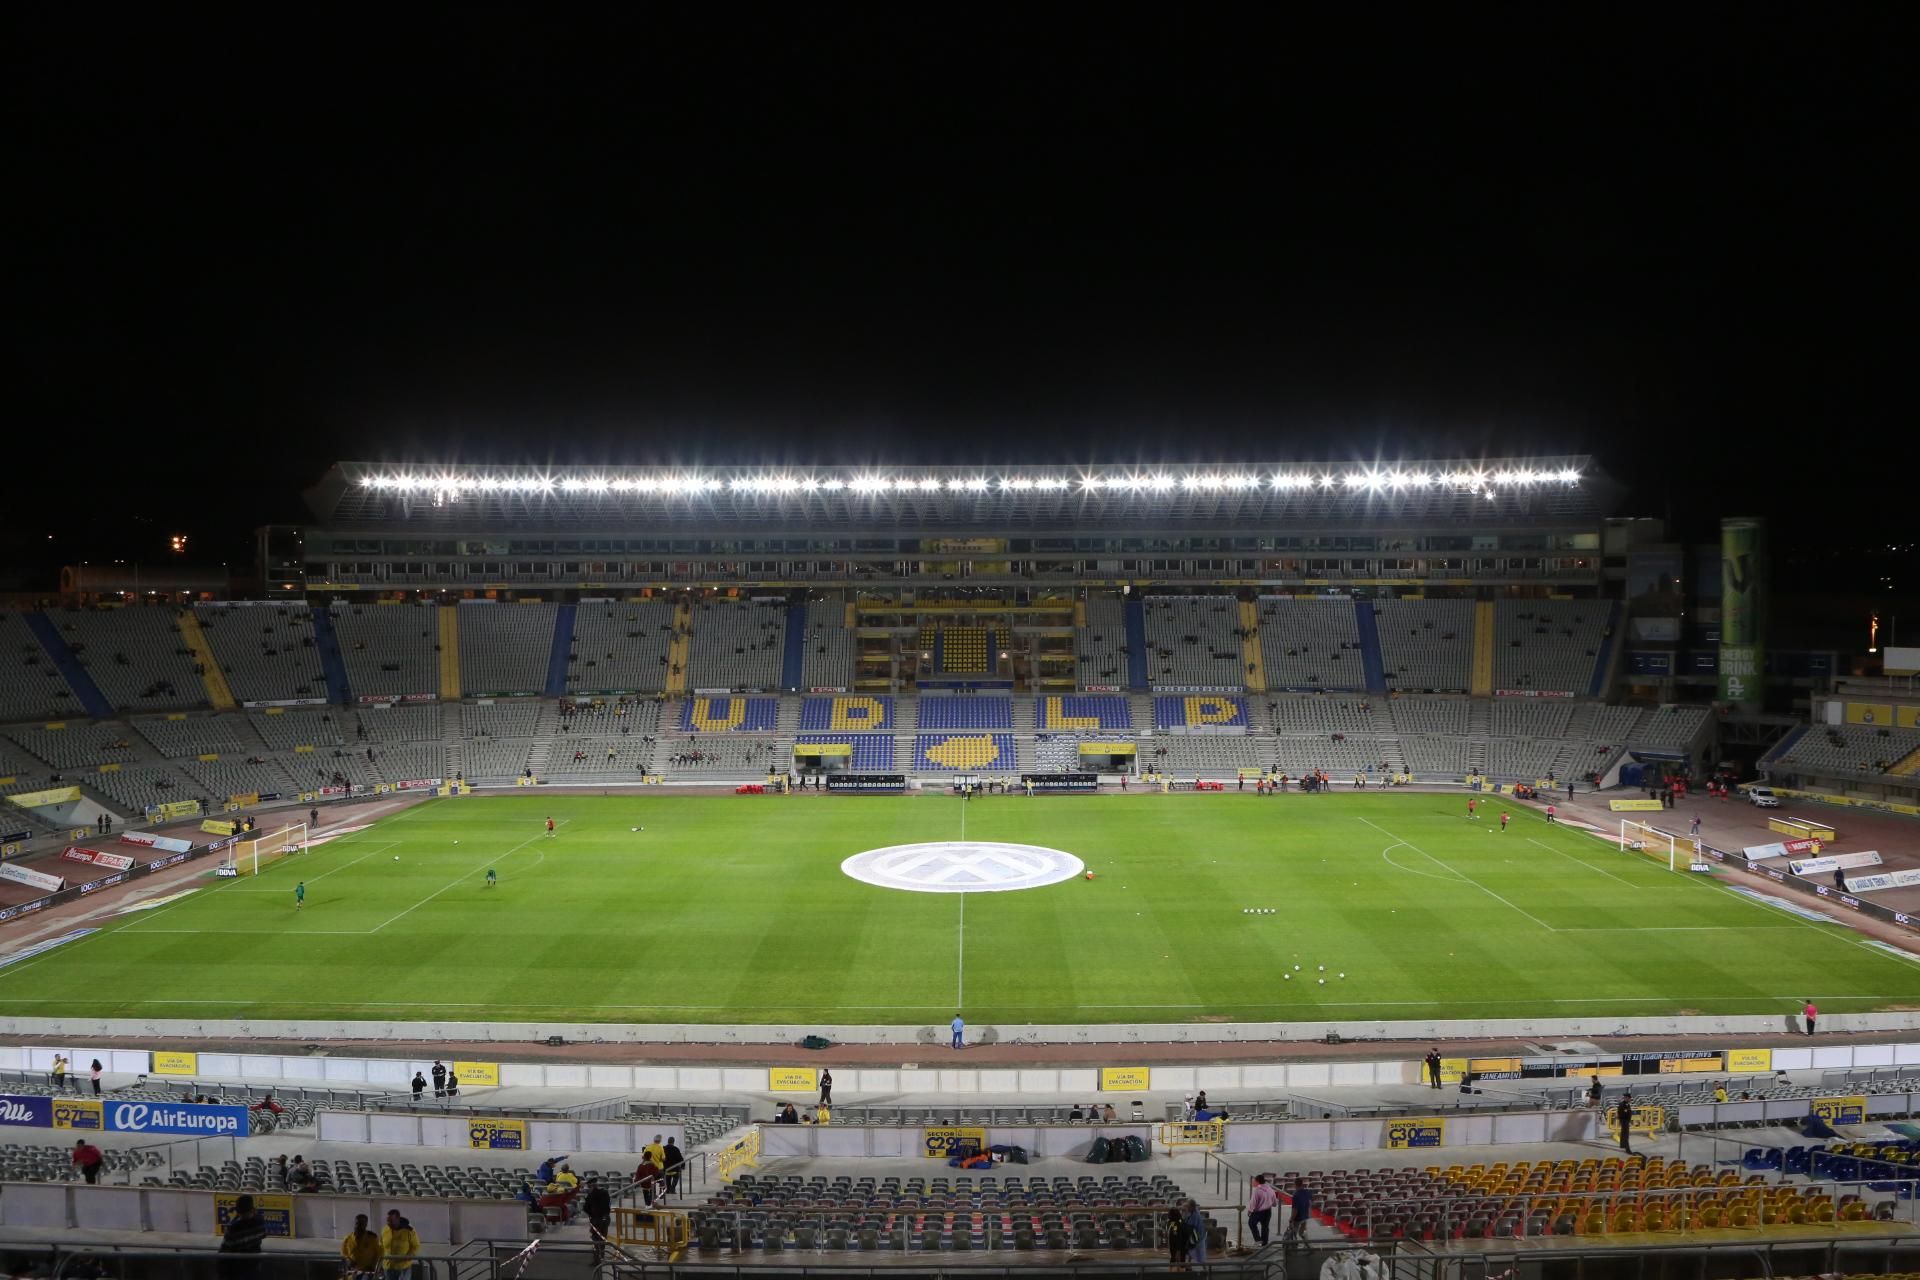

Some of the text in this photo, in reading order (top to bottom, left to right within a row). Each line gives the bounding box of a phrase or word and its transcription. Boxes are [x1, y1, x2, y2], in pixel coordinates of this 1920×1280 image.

[101, 855, 123, 867] SPAR
[218, 867, 237, 877] BBVA
[1691, 863, 1709, 872] BBVA
[1817, 885, 1859, 907] IOC dental
[1895, 912, 1909, 924] IOC
[55, 1109, 80, 1121] C27
[1816, 1107, 1840, 1119] C31
[470, 1128, 498, 1141] C28
[1389, 1128, 1417, 1141] C30
[926, 1137, 956, 1150] C29
